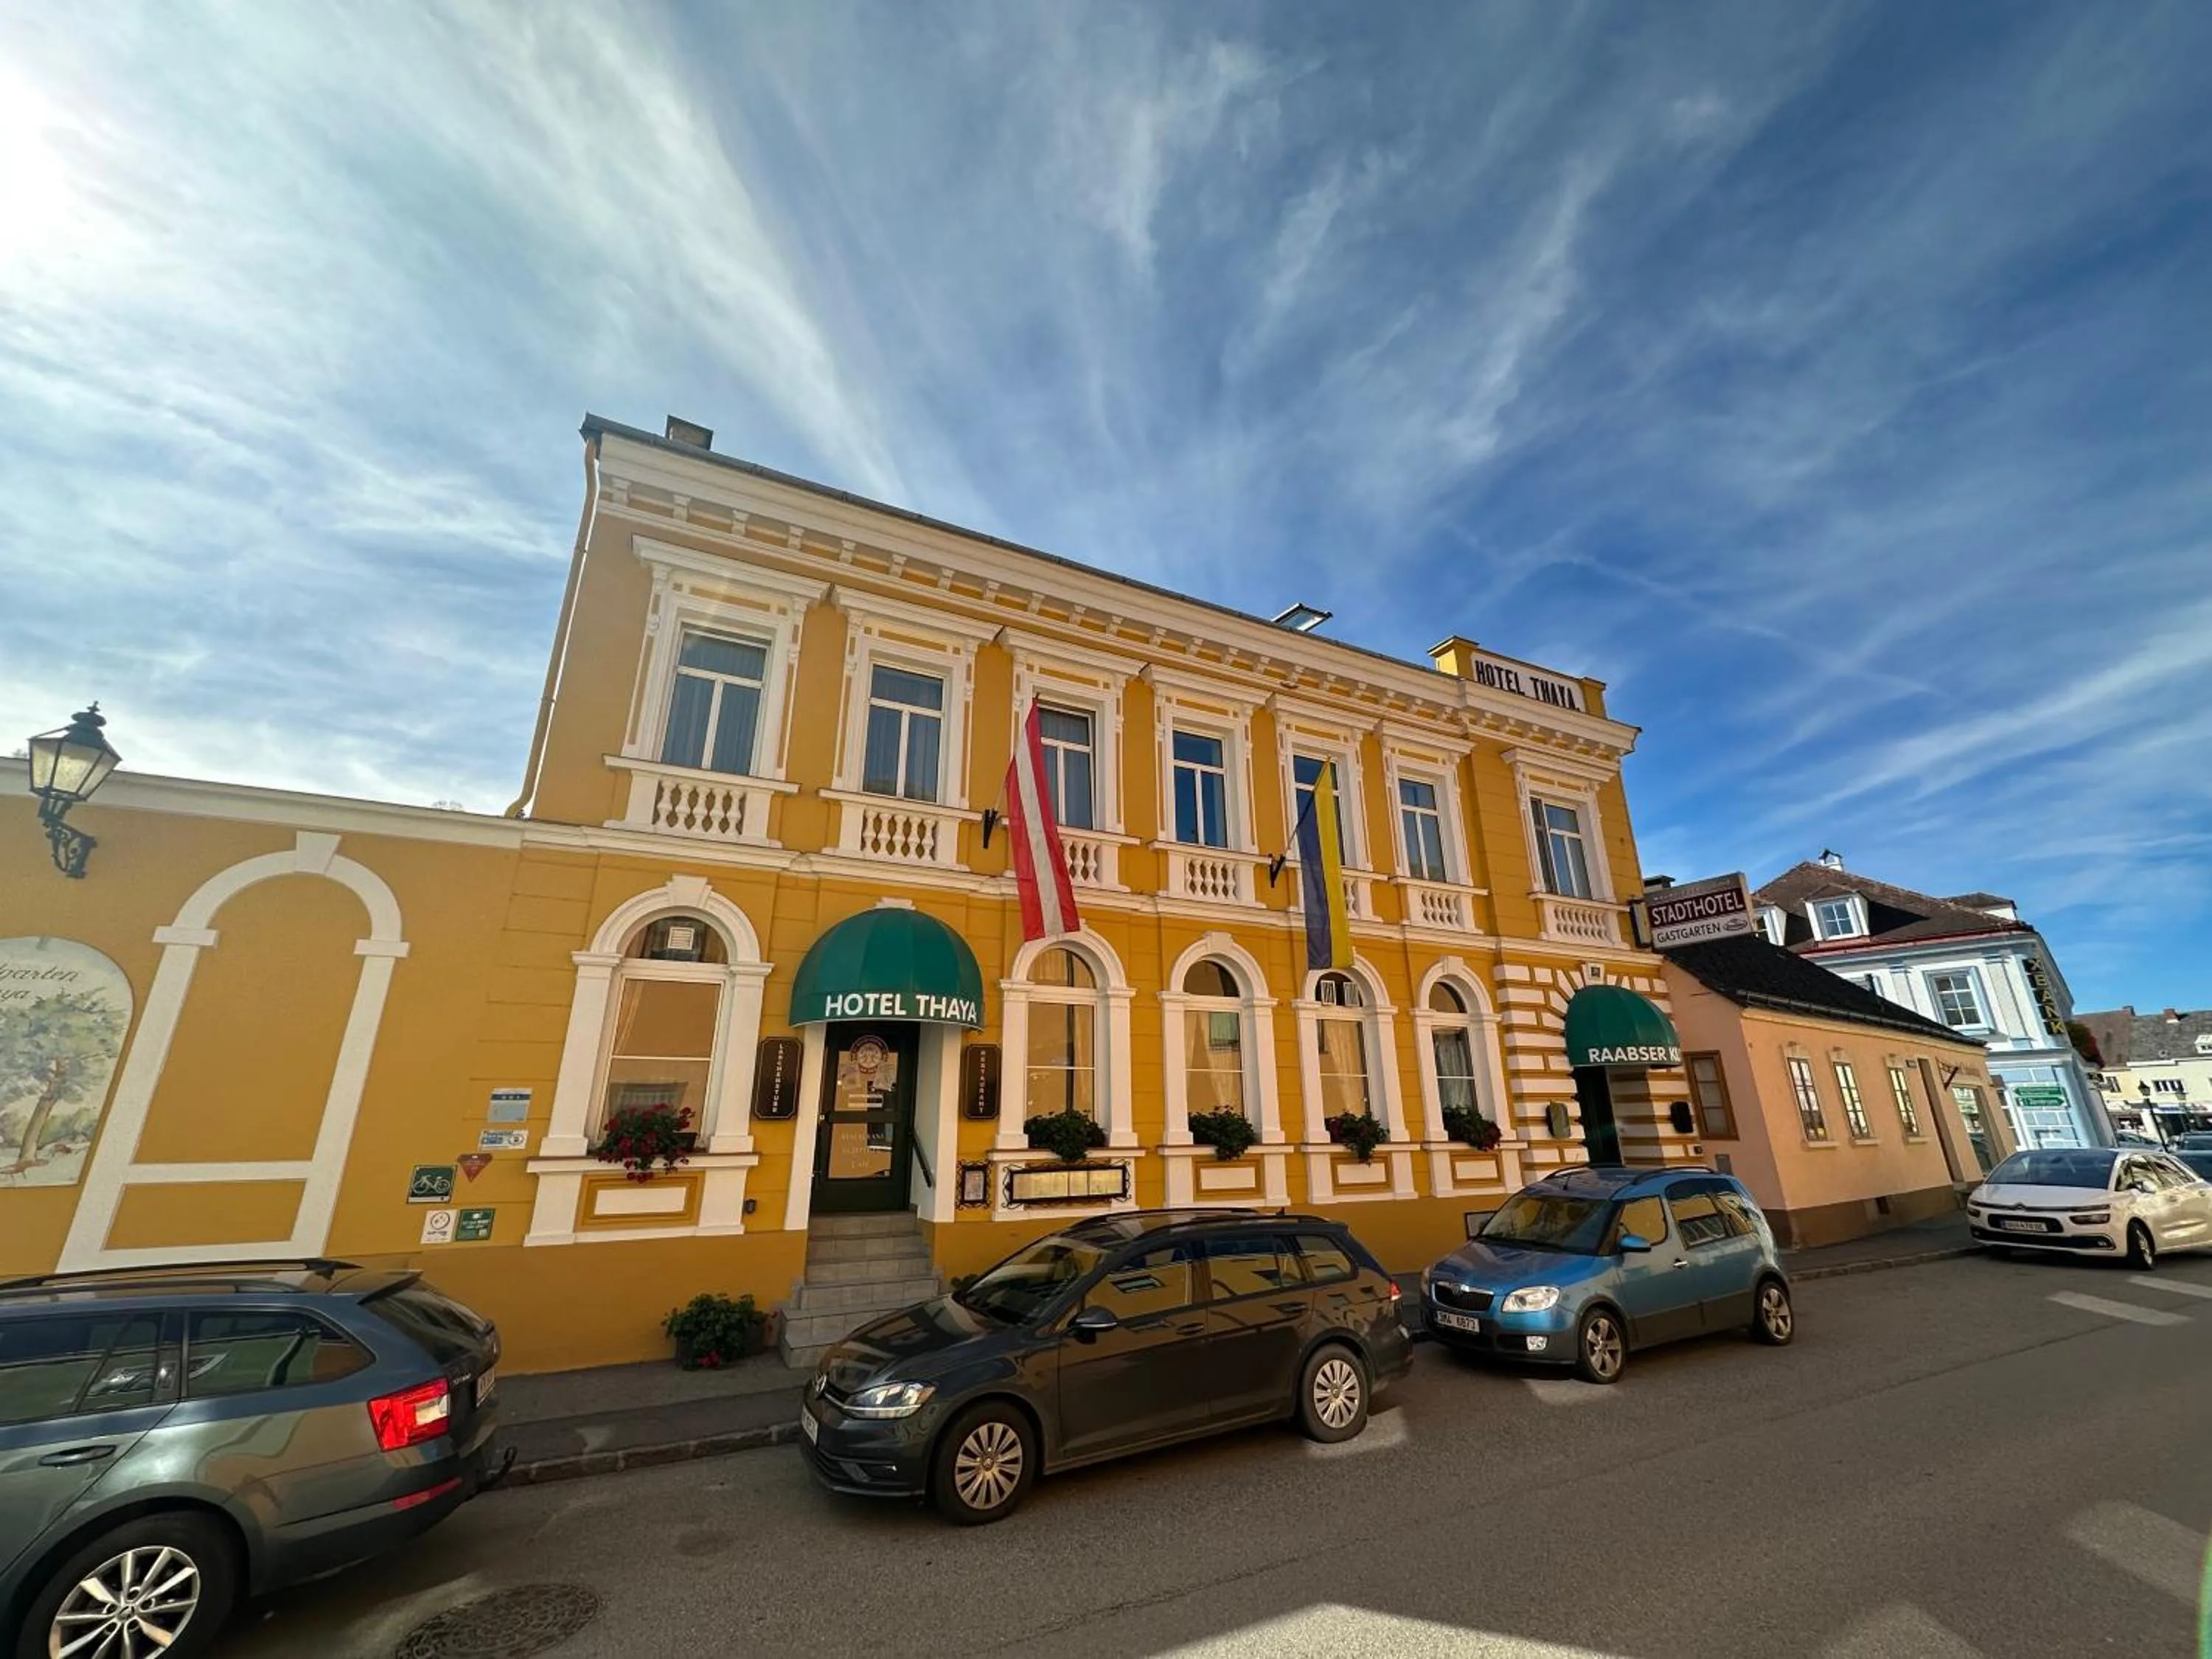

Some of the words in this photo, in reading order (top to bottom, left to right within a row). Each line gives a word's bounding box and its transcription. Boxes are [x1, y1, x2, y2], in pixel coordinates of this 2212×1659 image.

[1475, 661, 1526, 696] HOTEL
[1652, 890, 1745, 925] STADTHOTEL
[1657, 922, 1722, 943] GASTGARTEN
[825, 993, 907, 1017] HOTEL
[916, 994, 977, 1023] THAYA
[1588, 1047, 1667, 1062] RAABSER
